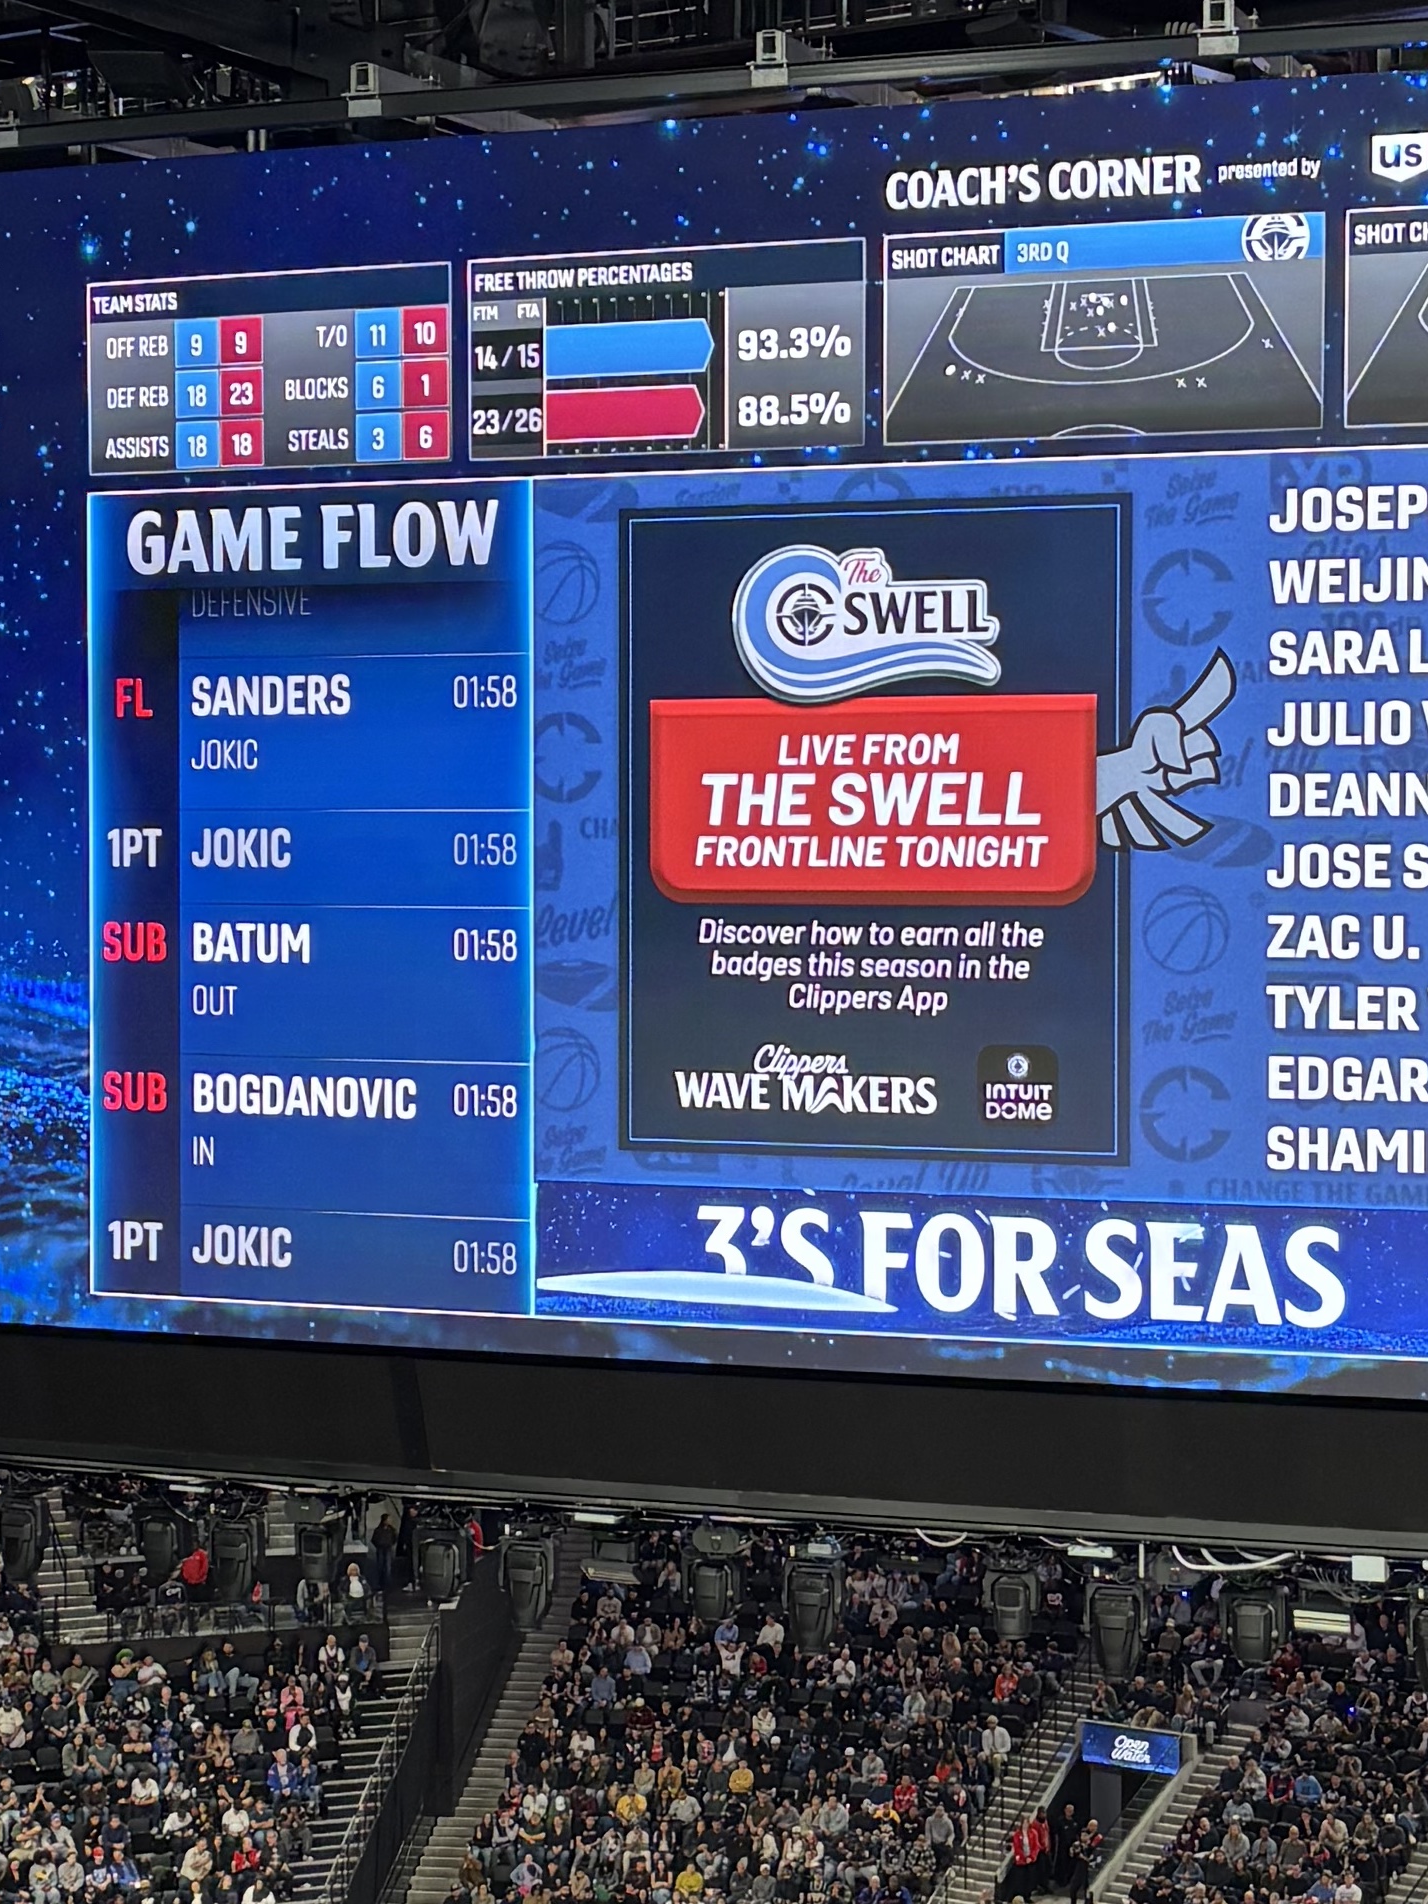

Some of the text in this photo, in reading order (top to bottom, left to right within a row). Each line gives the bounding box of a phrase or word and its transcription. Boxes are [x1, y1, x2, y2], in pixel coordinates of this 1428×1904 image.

[886, 154, 1321, 211] COACH'S CORNER presented by
[1353, 219, 1401, 246] SHOT
[891, 237, 1069, 270] SHOT CHART 3RD Q
[475, 263, 692, 292] FREE THROW PERCENTAGES
[93, 292, 177, 313] TEAM STATS
[106, 335, 169, 360] OFF REB
[316, 325, 348, 348] T/O
[737, 326, 851, 361] 93.3%
[106, 385, 169, 408] DEF REB
[284, 376, 349, 400] BLOCKS
[737, 393, 851, 427] 88.5%
[105, 436, 169, 460] ASSISTS
[288, 428, 349, 452] STEALS
[127, 500, 498, 575] GAME FLOW
[843, 560, 989, 635] The SWELL
[1270, 629, 1405, 676] SARA
[114, 675, 517, 719] FL SANDERS 01:58
[1267, 701, 1411, 747] JULIO
[190, 740, 259, 771] JOKIC
[778, 733, 960, 767] LIVE FROM
[700, 773, 1042, 827] THE SWELL
[107, 828, 517, 870] 1PT JOKIC 01:58
[694, 836, 1048, 869] FRONTLINE TONIGHT
[1267, 844, 1392, 889] JOSE
[103, 921, 517, 964] SUB BATUM 01:58
[699, 920, 1044, 949] Discover how to earn all the
[1267, 914, 1420, 960] ZAC U.
[712, 952, 1030, 983] badges this season in the
[192, 985, 238, 1016] OUT
[788, 985, 948, 1017] Clippers App
[1266, 986, 1419, 1032] TYLER
[753, 1046, 848, 1079] Clippers
[103, 1071, 517, 1119] SUB BOGDANOVIC 01:58
[675, 1073, 937, 1116] WAVE MAKERS
[192, 1136, 214, 1166] IN
[108, 1220, 517, 1275] 1PT JOKIC 01:58
[863, 1214, 1059, 1322] FOR
[1084, 1218, 1346, 1329] SEAS
